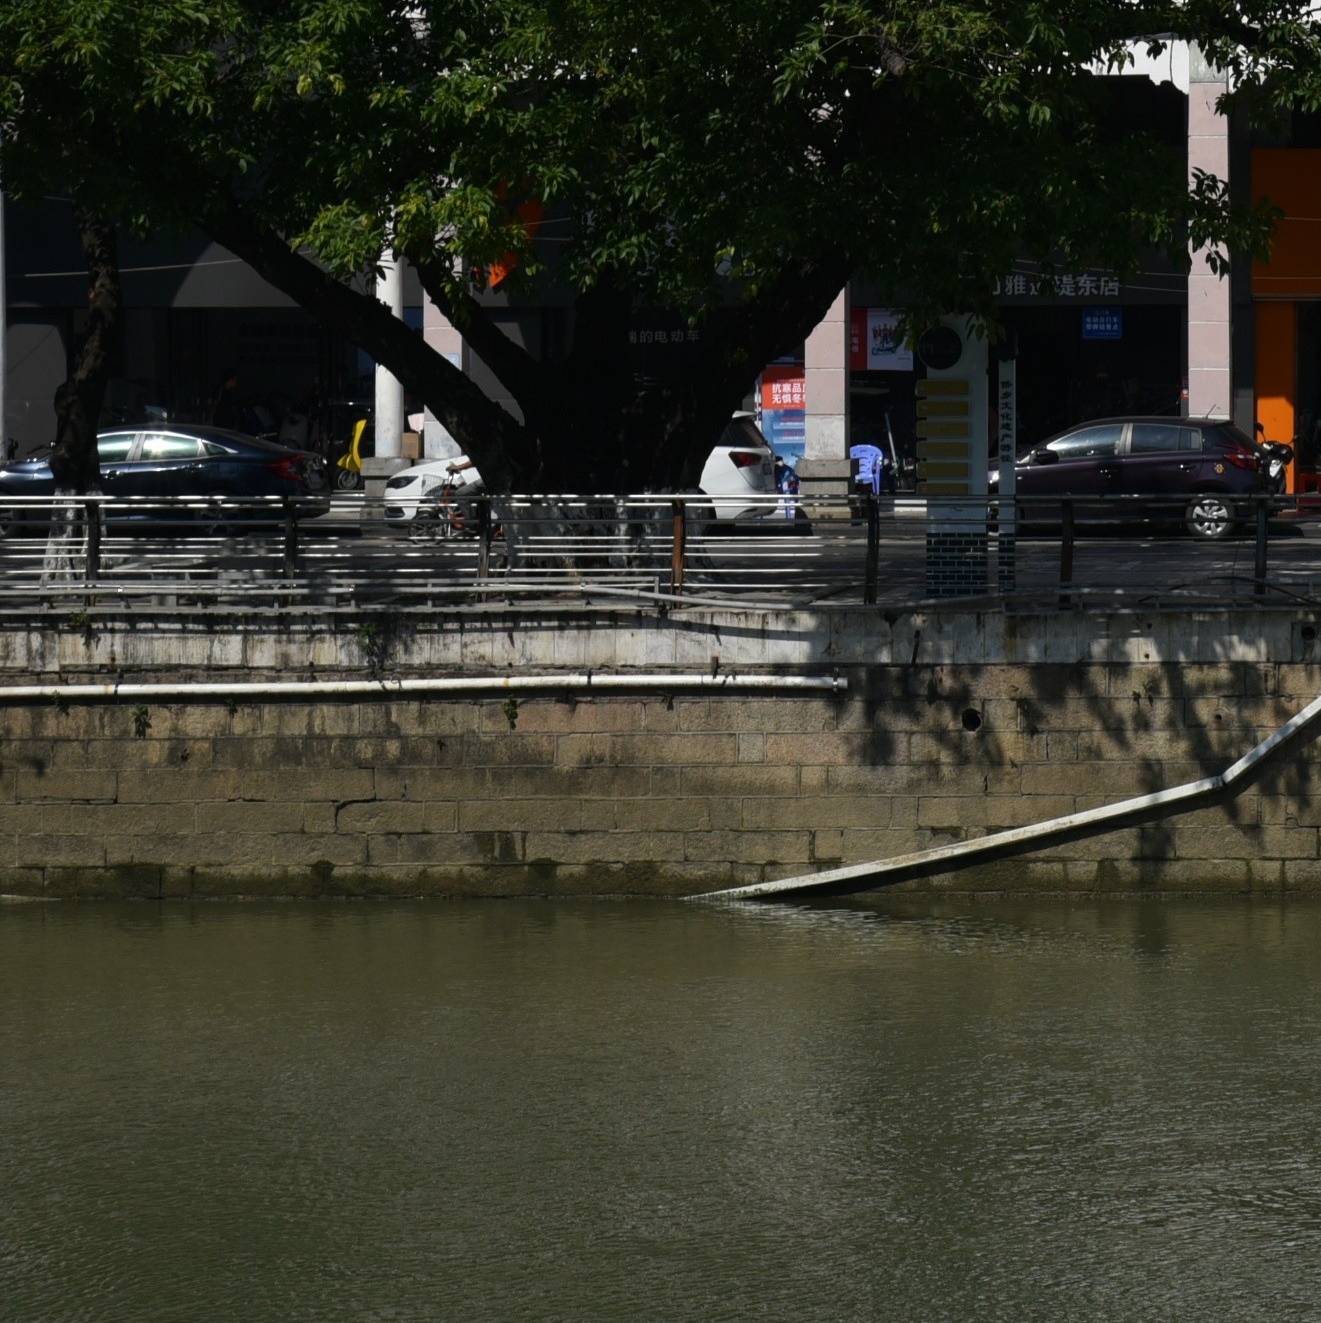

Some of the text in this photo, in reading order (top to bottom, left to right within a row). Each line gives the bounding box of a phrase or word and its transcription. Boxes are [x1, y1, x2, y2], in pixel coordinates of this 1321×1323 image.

[772, 383, 805, 393] 抗寒品
[772, 393, 805, 404] 无惧冬
